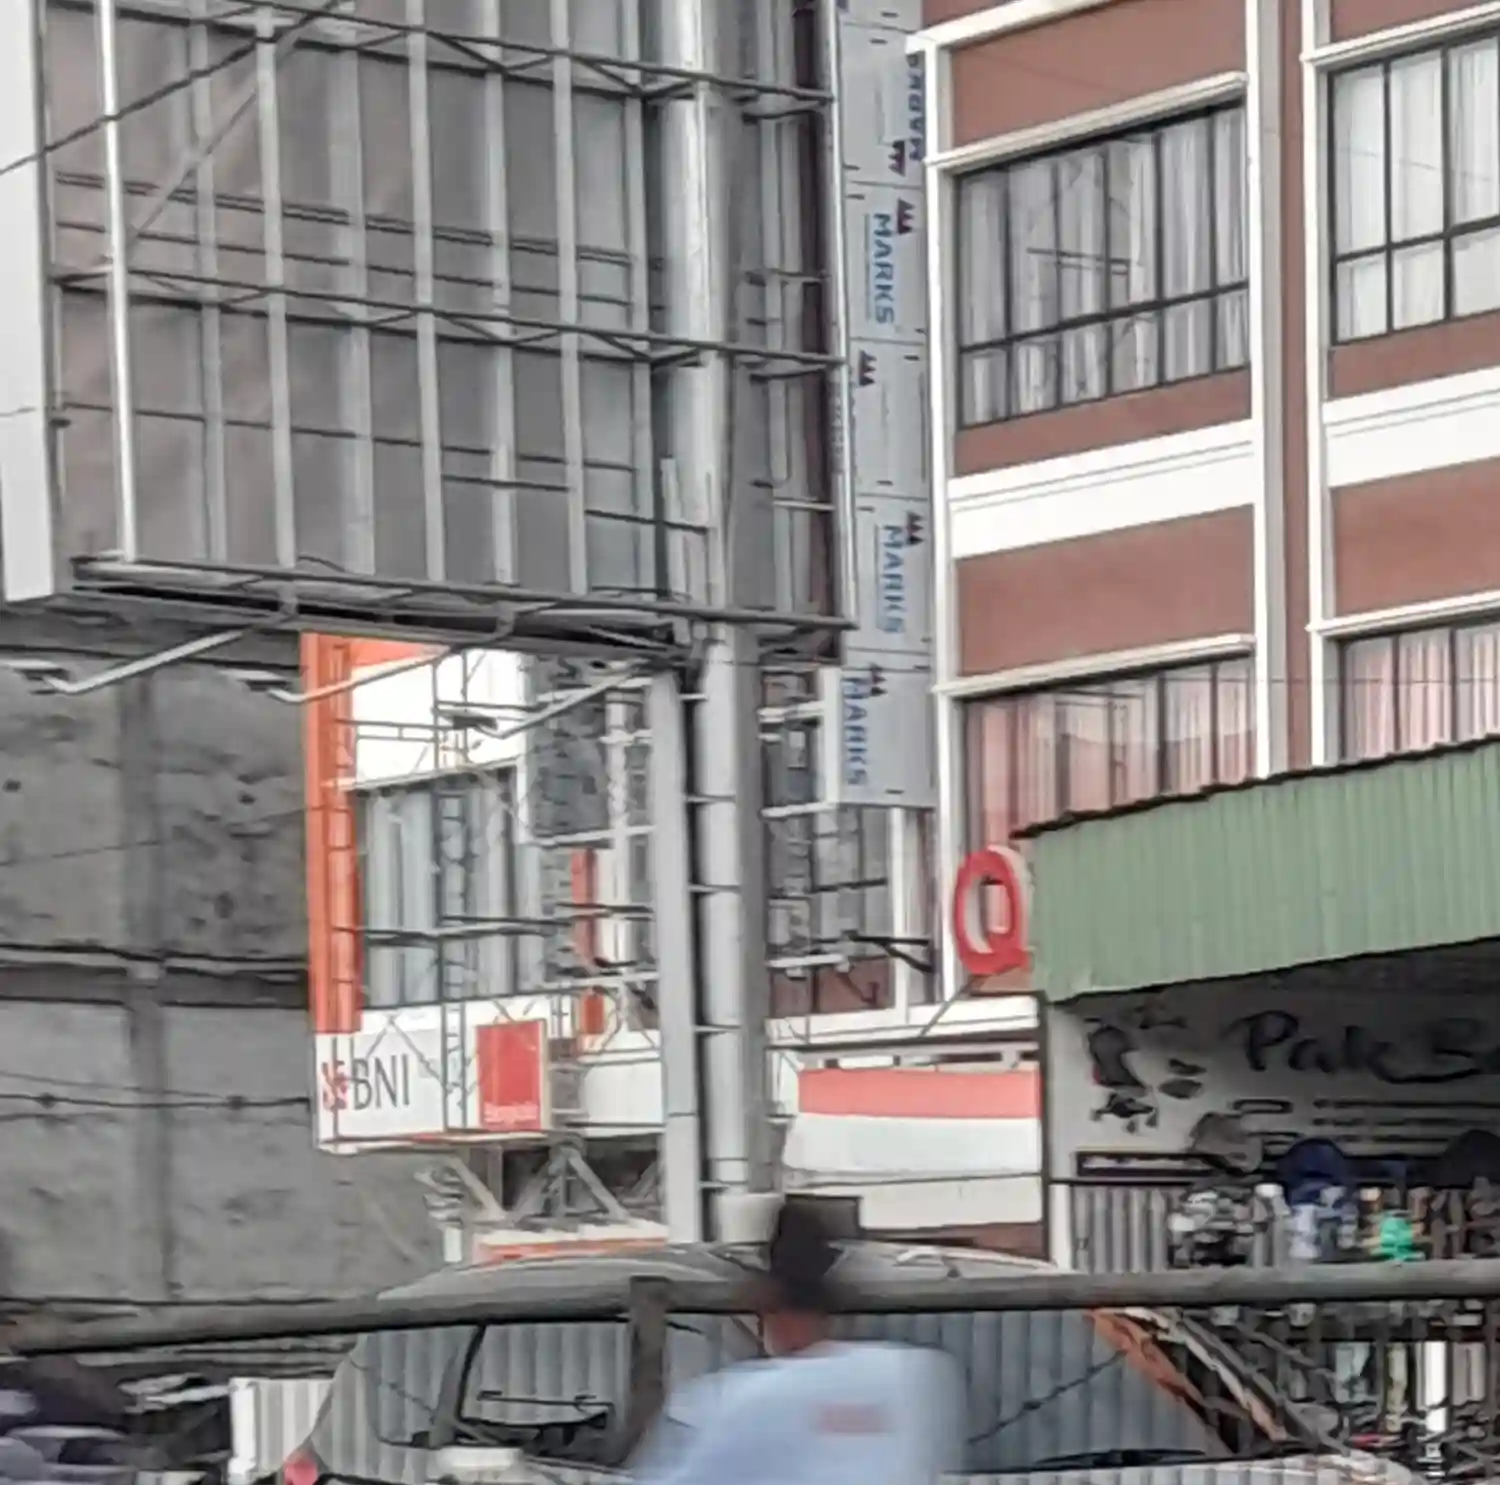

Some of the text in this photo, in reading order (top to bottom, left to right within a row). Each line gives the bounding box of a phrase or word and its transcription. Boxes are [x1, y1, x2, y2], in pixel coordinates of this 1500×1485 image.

[872, 212, 895, 325] MARKS
[881, 524, 906, 634] MARKS
[955, 849, 1031, 977] Q
[352, 1052, 411, 1111] BNI
